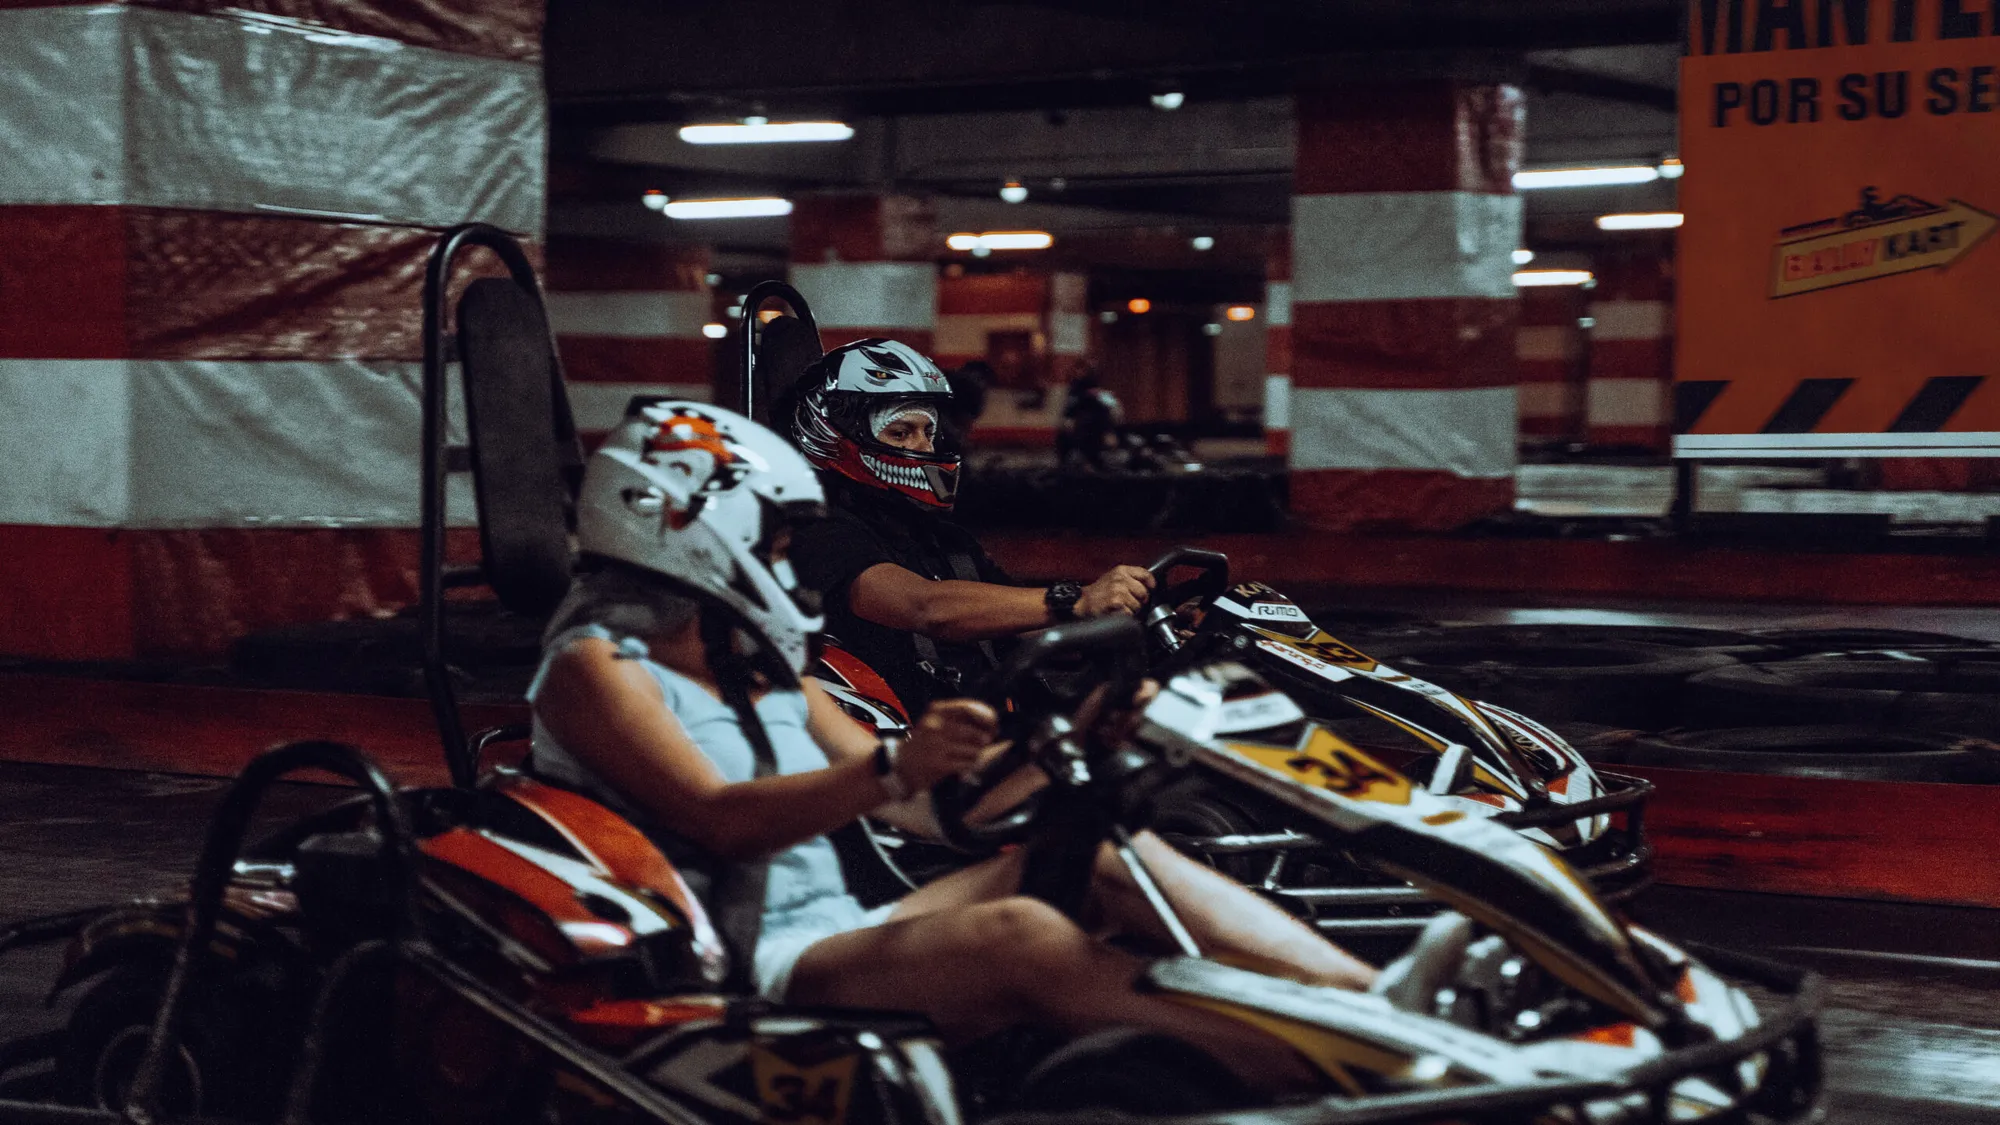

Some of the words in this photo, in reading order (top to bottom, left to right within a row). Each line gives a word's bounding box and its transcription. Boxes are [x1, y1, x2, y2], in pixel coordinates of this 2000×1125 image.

[1711, 78, 1820, 127] POR
[1838, 70, 1908, 120] SU
[1927, 66, 1997, 115] SE
[1286, 750, 1398, 797] 34
